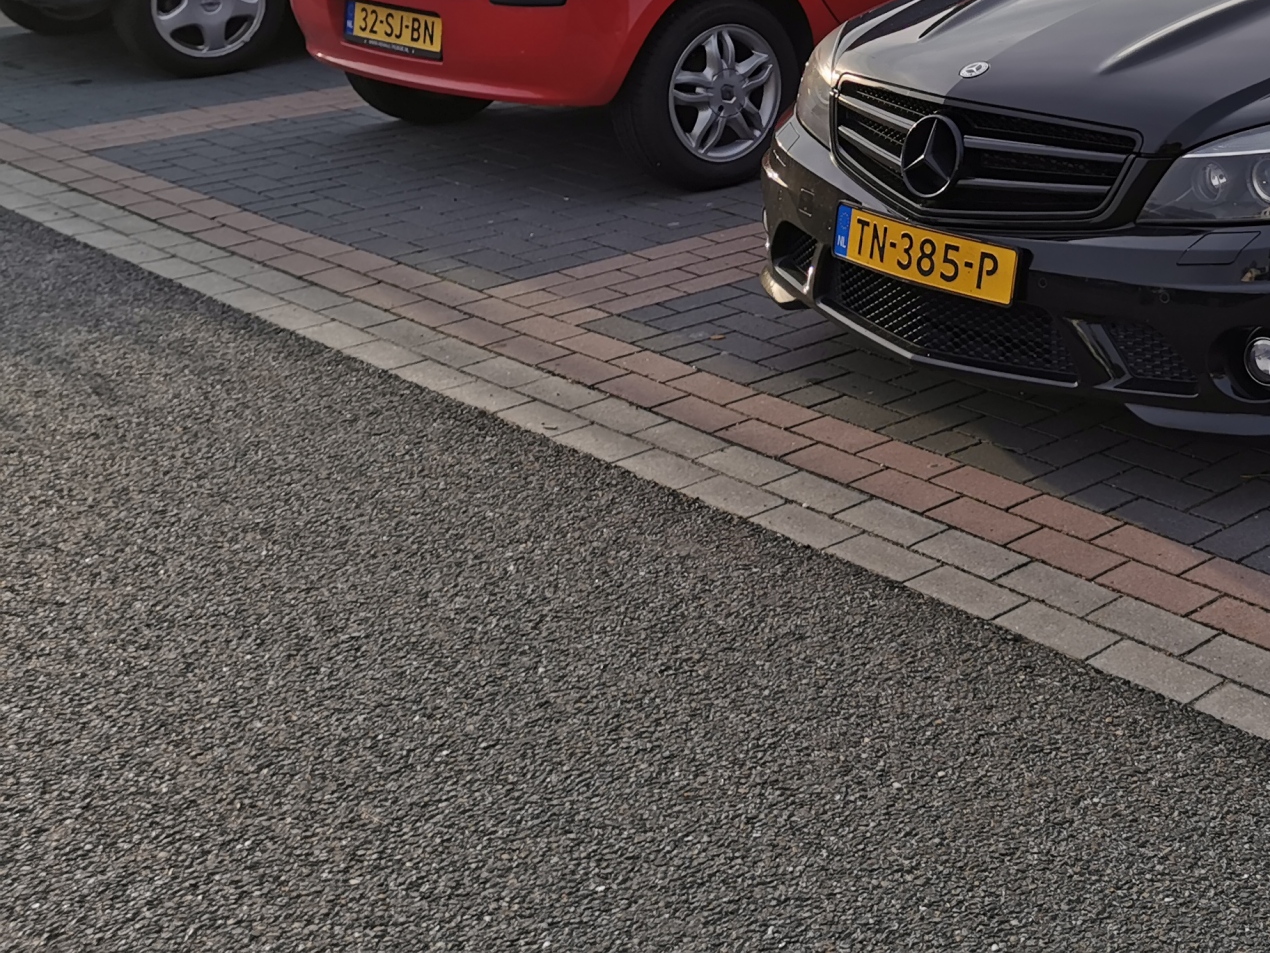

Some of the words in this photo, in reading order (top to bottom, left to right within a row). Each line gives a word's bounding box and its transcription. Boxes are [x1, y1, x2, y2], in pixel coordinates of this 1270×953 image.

[359, 6, 435, 46] 32-SJ-BN
[837, 234, 847, 248] NL
[857, 218, 999, 290] TN-385-P
